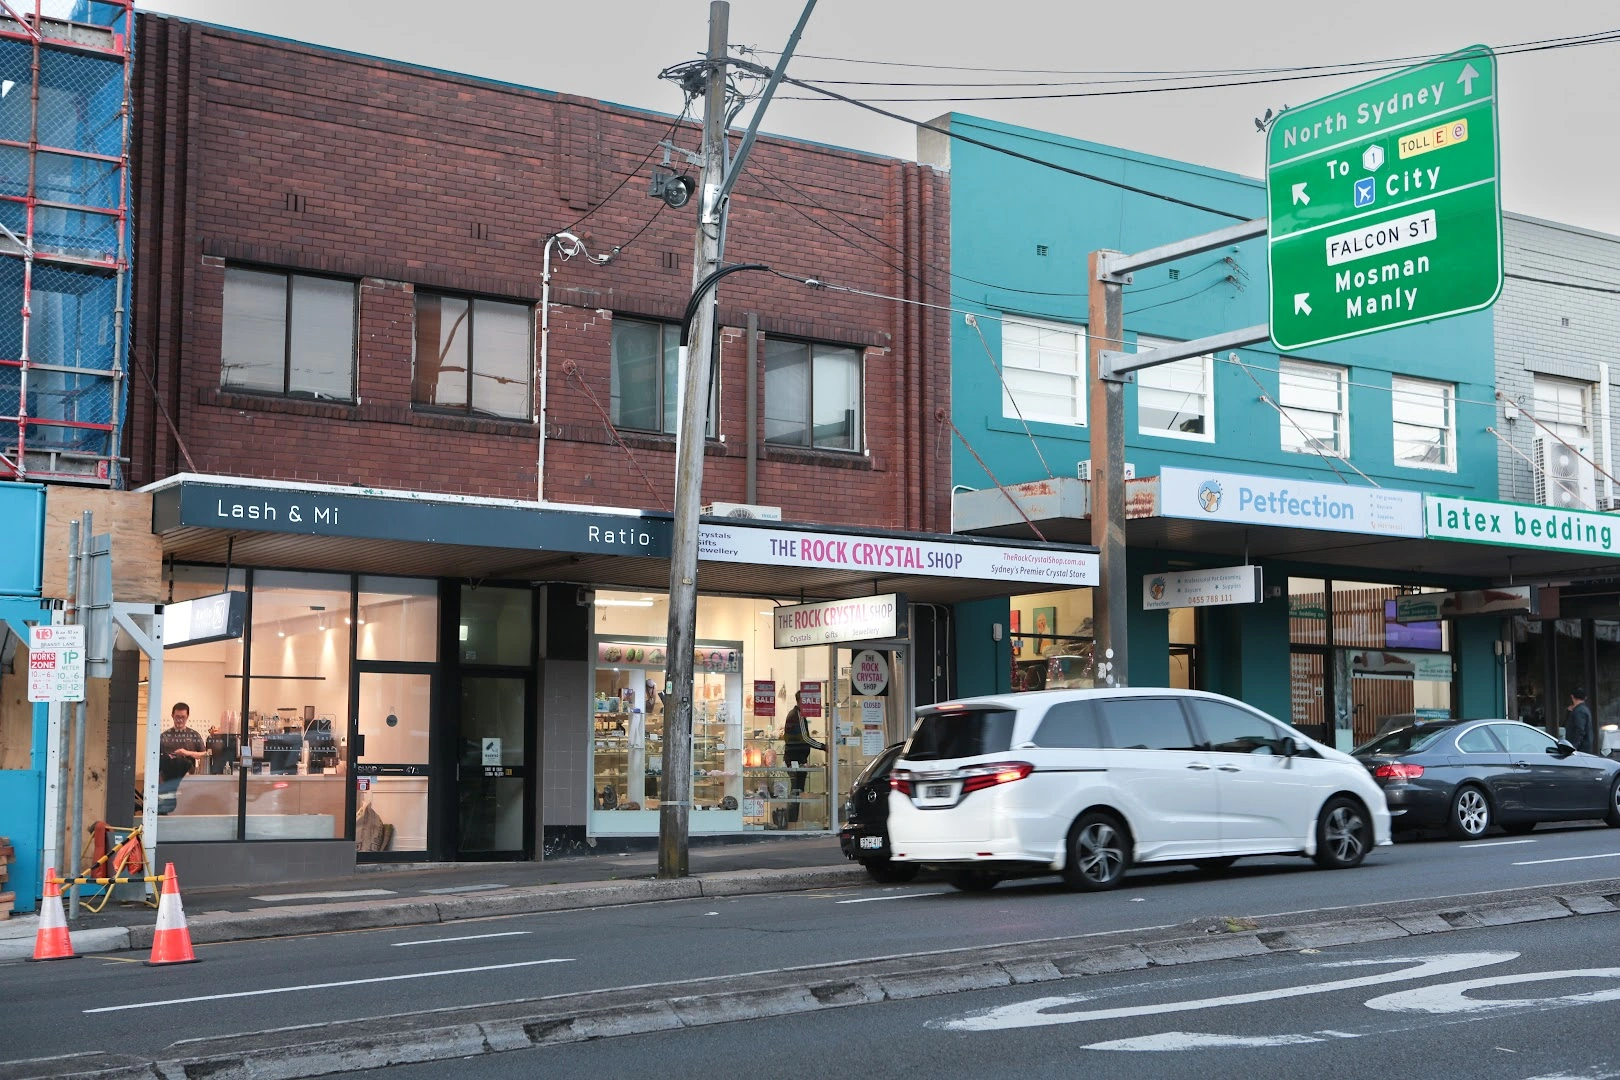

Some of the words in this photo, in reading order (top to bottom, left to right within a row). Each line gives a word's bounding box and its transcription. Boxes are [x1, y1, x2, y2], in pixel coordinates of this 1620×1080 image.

[1284, 112, 1347, 148] North
[1356, 82, 1445, 125] Sydney
[1401, 135, 1430, 154] TOLL
[1436, 130, 1444, 144] E
[1326, 160, 1350, 180] To
[1386, 166, 1440, 196] City
[1330, 226, 1399, 258] FALCON
[1409, 218, 1431, 238] ST
[1335, 256, 1430, 293] Mosman
[1346, 288, 1418, 318] Manly
[218, 499, 276, 521] Lash
[289, 506, 302, 522] &
[314, 508, 339, 524] Mi
[1240, 487, 1354, 520] Petfection
[588, 526, 650, 546] Ratio
[1438, 502, 1500, 533] latex
[1514, 511, 1611, 549] bedding
[770, 539, 797, 557] THE
[801, 538, 848, 563] ROCK
[852, 542, 924, 569] CRYSTAL
[927, 551, 962, 569] SHOP
[1003, 553, 1086, 566] TheRockCrystalShop.com.au
[991, 564, 1019, 575] Sydney's
[1020, 567, 1045, 576] Premier
[1046, 568, 1068, 578] Crystal
[1069, 570, 1086, 578] Store
[779, 614, 792, 629] THE
[794, 609, 821, 629] ROCK
[824, 604, 868, 626] CRYSTAL
[870, 603, 892, 618] SHOP
[38, 629, 51, 639] T3
[790, 633, 811, 643] Crystals
[852, 628, 879, 636] Jewellery
[63, 652, 79, 664] 1P
[861, 663, 879, 672] ROCK
[856, 673, 884, 682] CRYSTAL
